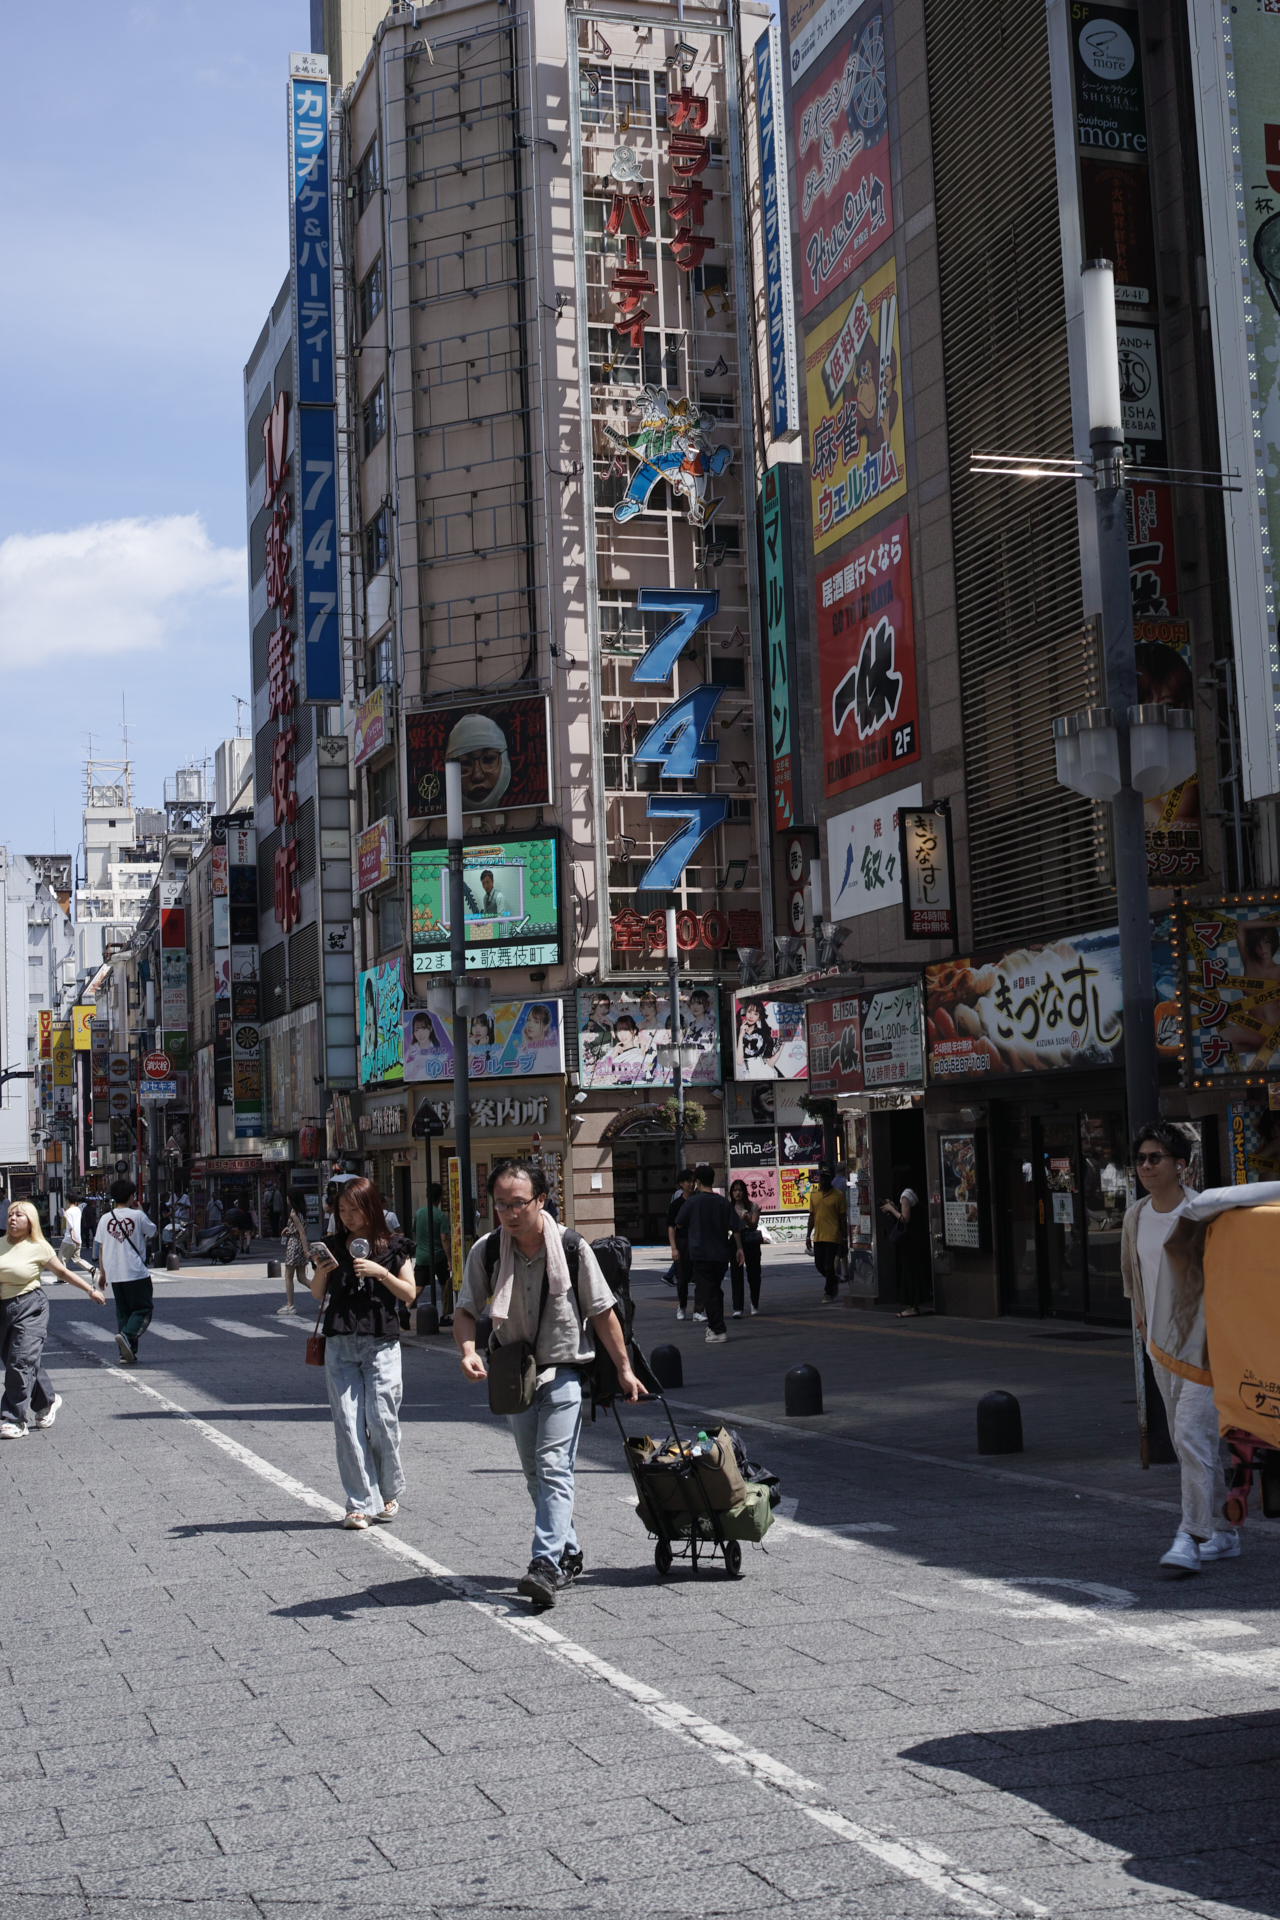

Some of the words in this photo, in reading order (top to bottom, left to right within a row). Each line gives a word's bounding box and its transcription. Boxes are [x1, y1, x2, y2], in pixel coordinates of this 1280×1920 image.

[1071, 4, 1089, 20] 5F
[1093, 58, 1126, 71] more
[1081, 80, 1138, 96] シーシャラウンジ
[1082, 91, 1130, 106] SHISHA
[799, 54, 858, 157] ダイニング
[1079, 126, 1147, 152] more
[667, 87, 716, 272] カラオケ
[802, 132, 864, 222] ダーツバー
[295, 89, 329, 383] カラオケ&パーティー
[829, 304, 868, 389] 低料金
[1116, 337, 1152, 350] TAND+
[1121, 406, 1156, 420] ISHA
[1121, 419, 1156, 432] FE&BAR
[812, 402, 860, 480] 麻雀
[303, 460, 337, 643] 747
[822, 534, 902, 608] 居酒屋行くなら
[832, 607, 845, 637] GO
[844, 600, 857, 629] TO
[858, 578, 895, 622] IZAKAYA
[764, 515, 790, 756] マルハン
[526, 710, 547, 793] 新店舗
[630, 587, 730, 890] 747
[894, 727, 912, 757] 2F
[508, 713, 528, 794] オープン
[827, 746, 861, 785] IZAKAYA
[861, 736, 889, 772] IKKYU
[861, 841, 903, 892] 叙々
[913, 814, 943, 906] きづなすし
[912, 922, 950, 933] 年中無休
[913, 911, 947, 921] 24時間
[611, 908, 762, 951] 全300室
[416, 953, 446, 971] 22ま
[480, 946, 545, 969] 歌舞伎町
[994, 954, 1122, 1047] きづなすし
[1192, 920, 1231, 1068] マドンナ
[873, 995, 912, 1022] シーシャ
[934, 1040, 952, 1055] 24時間
[952, 1039, 973, 1053] 年中無休
[1036, 1039, 1054, 1047] KIZUNA
[1055, 1037, 1071, 1046] SUSHI
[147, 1060, 168, 1071] 消火栓
[596, 1056, 643, 1075] alma
[867, 1061, 910, 1083] 24時間営業!
[150, 1081, 176, 1091] セキネ
[730, 1142, 762, 1155] alma
[746, 1181, 766, 1190] ーるど
[761, 1216, 791, 1224] SHISHA
